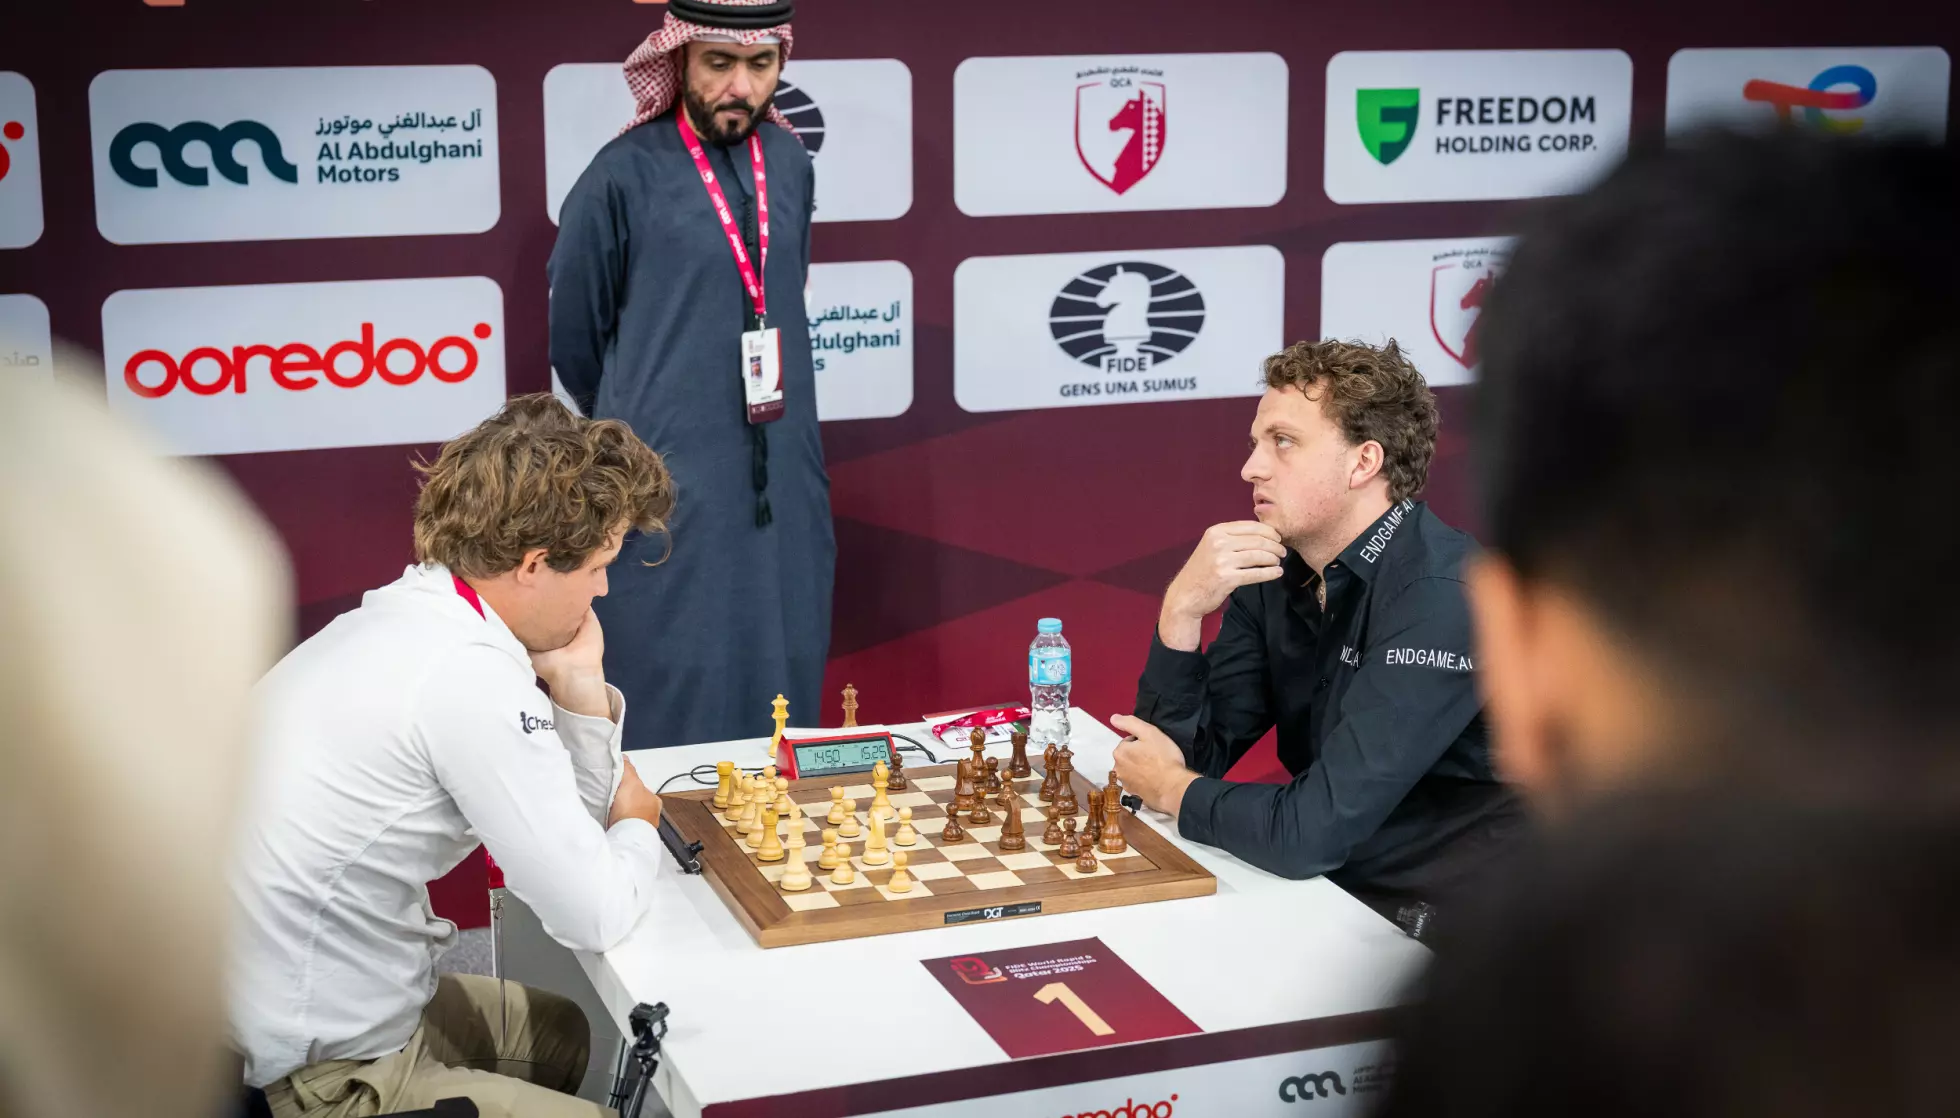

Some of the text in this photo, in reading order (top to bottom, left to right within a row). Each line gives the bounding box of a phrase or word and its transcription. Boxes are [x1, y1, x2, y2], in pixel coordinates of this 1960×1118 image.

[1109, 78, 1132, 88] QCA
[1436, 96, 1596, 126] FREEDOM
[315, 109, 482, 138] آل عبدالغني موتورز
[317, 139, 483, 163] Al Abdulghani
[1436, 134, 1597, 154] HOLDING CORP.
[317, 165, 400, 184] Motors
[882, 301, 901, 322] آل
[811, 329, 901, 353] dulghani
[124, 322, 492, 398] ooredoo
[1106, 356, 1148, 374] FIDE
[1060, 377, 1198, 398] GENS UNA SUMUS
[1386, 648, 1473, 671] ENDGAME.AI
[983, 906, 1004, 919] DGT
[1005, 962, 1026, 970] FIDE
[1028, 959, 1056, 967] World
[1056, 955, 1084, 964] Rapid
[1014, 965, 1084, 979] Qatar 2025
[1030, 959, 1097, 972] Championships
[1033, 982, 1116, 1036] 1
